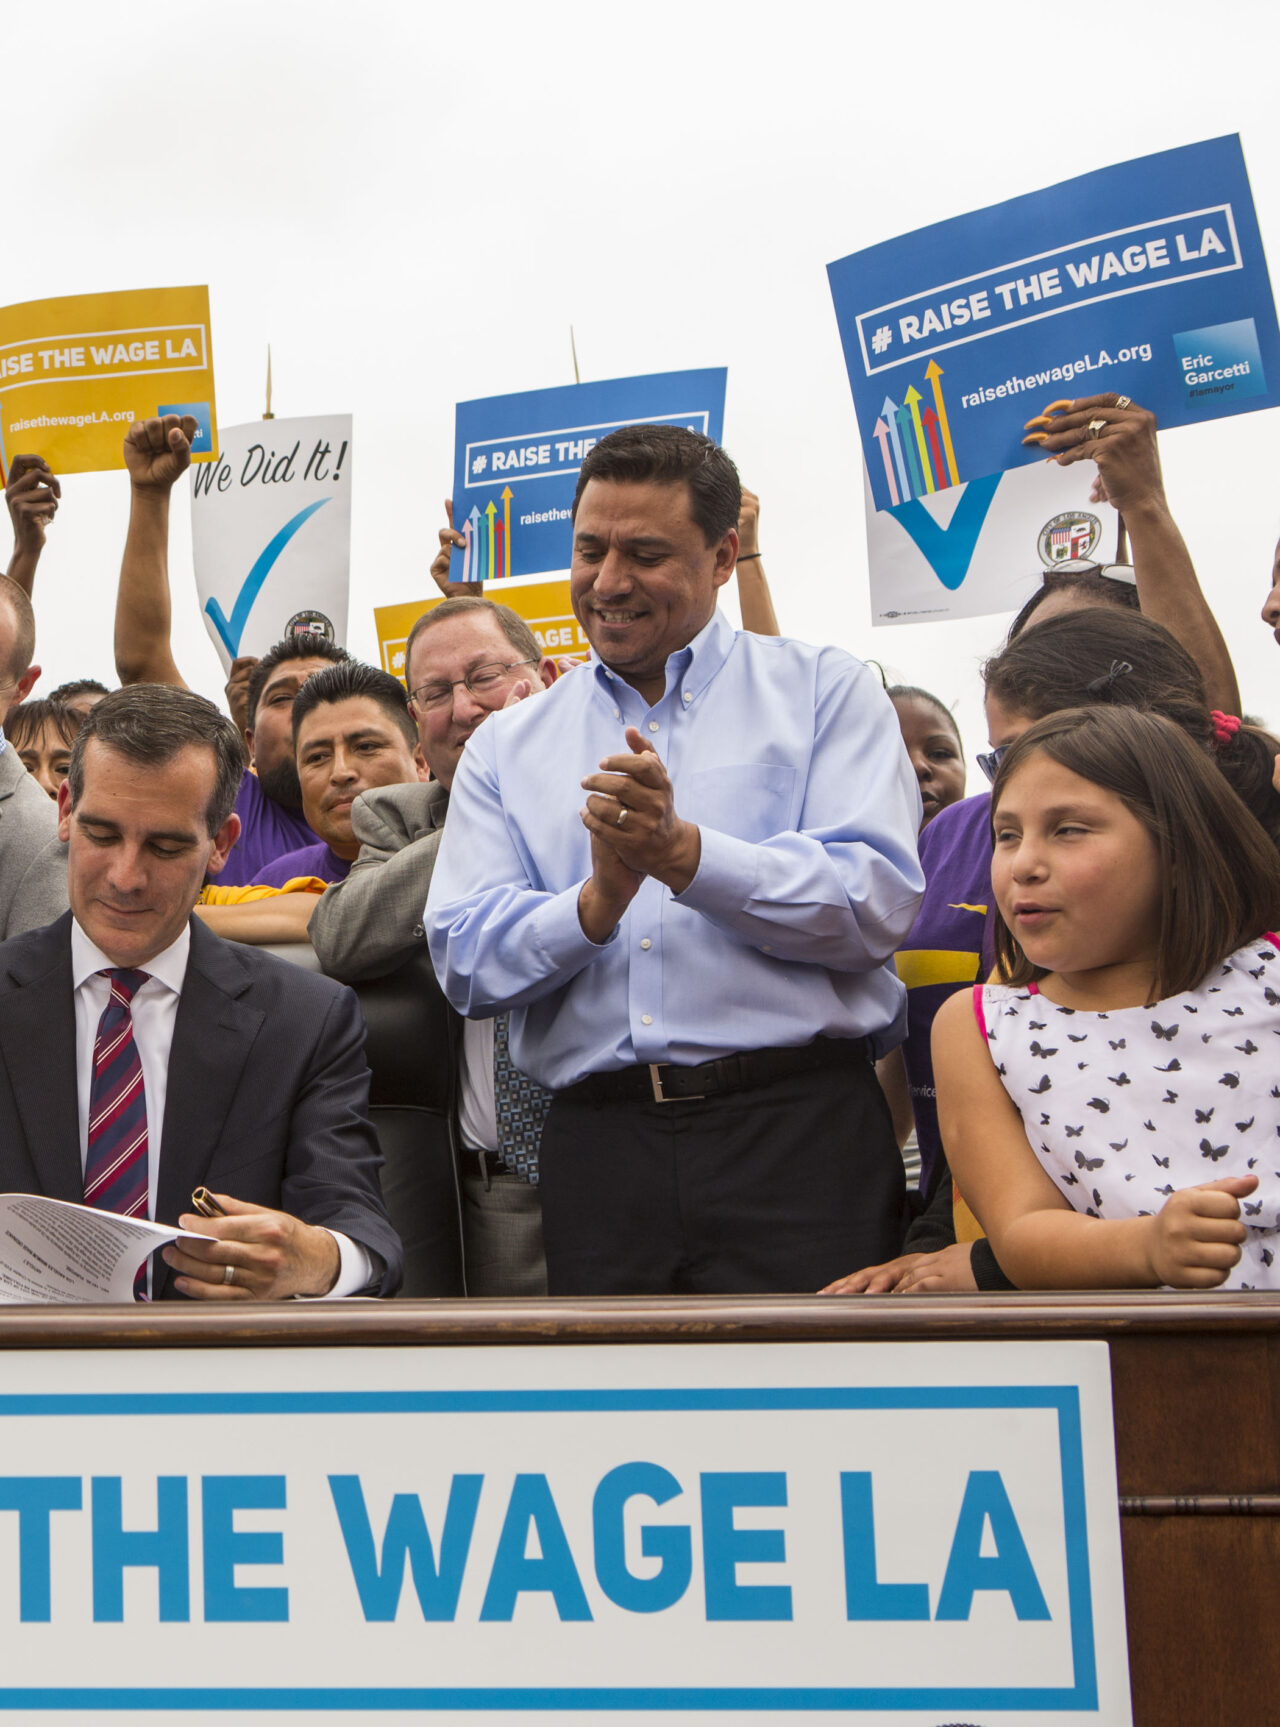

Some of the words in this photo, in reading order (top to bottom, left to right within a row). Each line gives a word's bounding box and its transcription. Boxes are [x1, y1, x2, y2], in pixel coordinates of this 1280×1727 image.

[871, 325, 893, 355] #
[899, 290, 991, 344] RAISE
[994, 268, 1062, 310] THE
[1065, 238, 1170, 288] WAGE
[1175, 227, 1226, 262] LA
[38, 347, 85, 370] THE
[90, 340, 160, 366] WAGE
[165, 338, 198, 358] LA
[1181, 354, 1214, 370] Eric
[961, 343, 1153, 408] raisethewageLA.org
[1184, 361, 1251, 385] Garcetti
[9, 410, 135, 433] raisethewageLA.org
[193, 451, 232, 499] We
[240, 439, 300, 487] Did
[303, 438, 348, 481] It!
[472, 454, 488, 474] #
[491, 444, 551, 472] RAISE
[535, 627, 573, 649] AGE
[326, 1461, 793, 1622] WAGE
[839, 1470, 1052, 1621] LA
